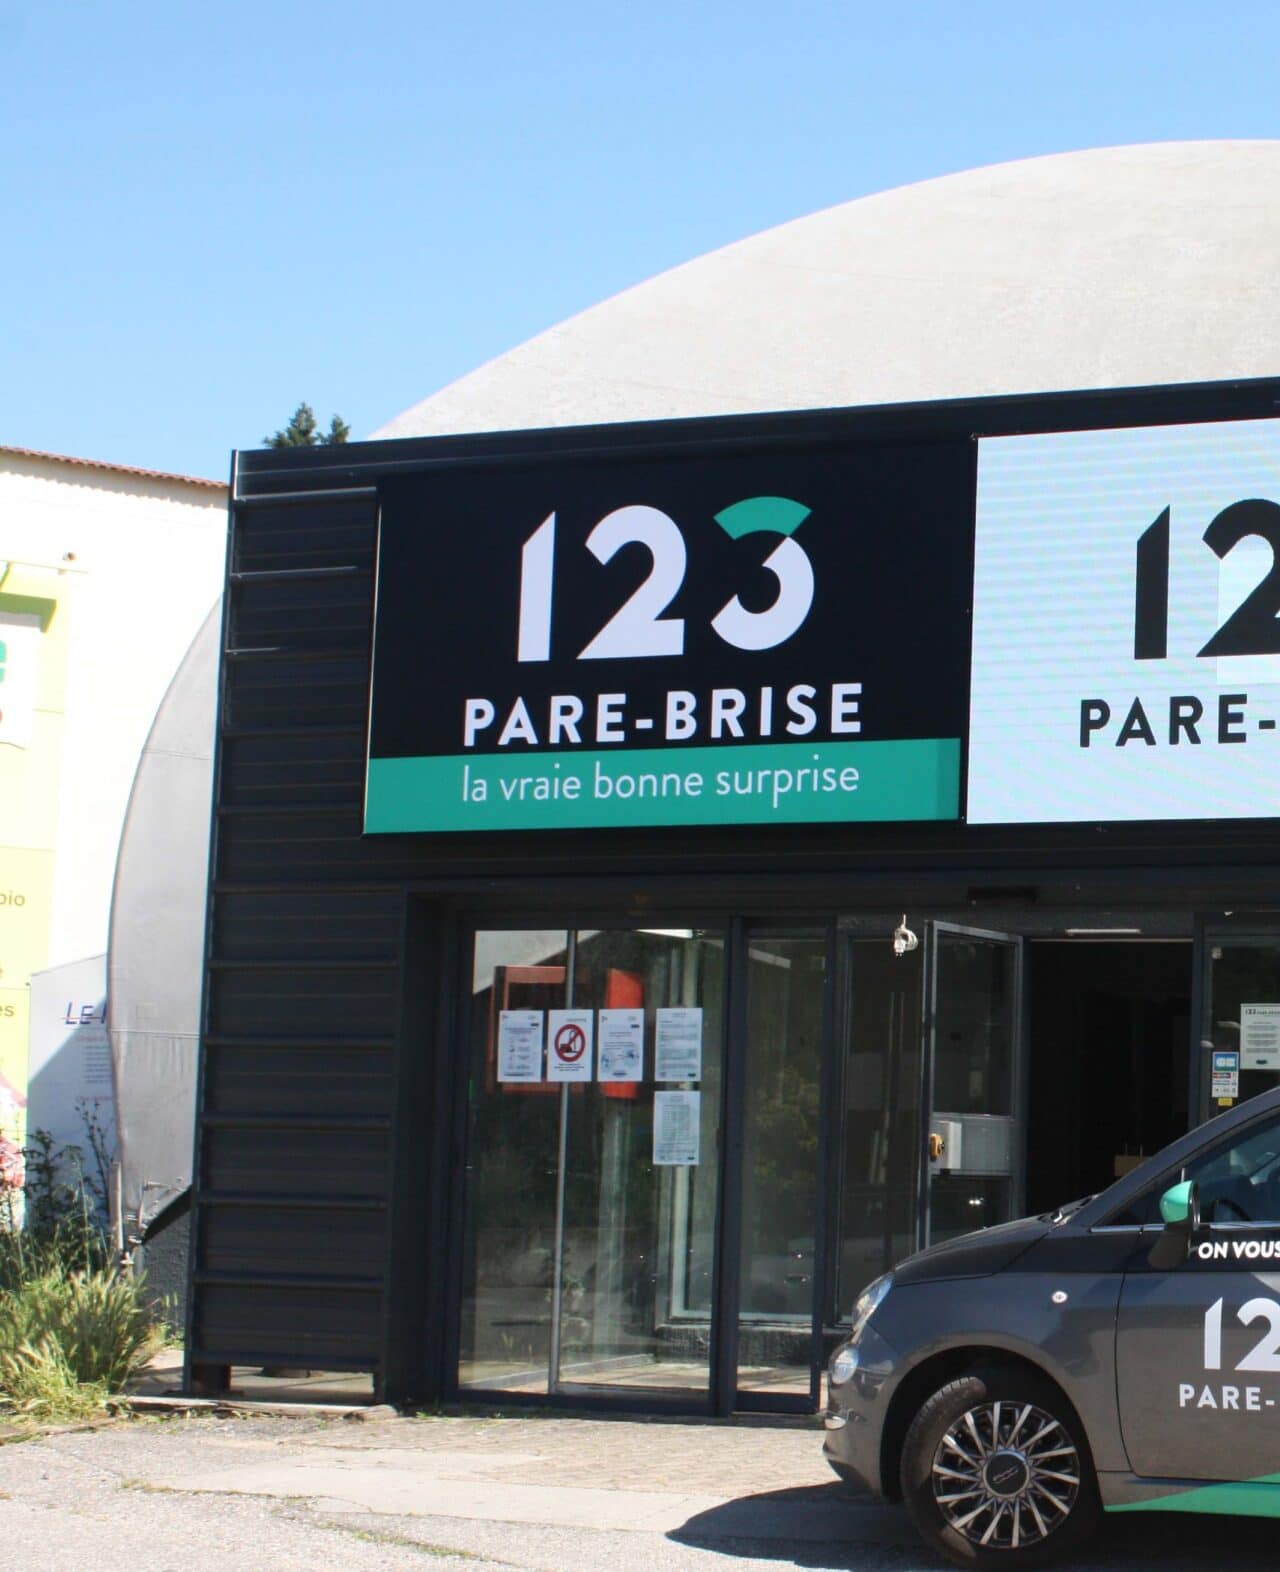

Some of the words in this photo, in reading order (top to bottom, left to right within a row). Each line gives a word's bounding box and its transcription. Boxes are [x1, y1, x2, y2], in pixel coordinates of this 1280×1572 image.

[517, 496, 815, 662] 123
[463, 682, 863, 747] PARE-BRISE
[463, 765, 488, 801] la
[500, 763, 581, 801] vraie
[594, 762, 704, 799] bonne
[716, 754, 860, 808] surprise
[1198, 1242, 1229, 1259] ON
